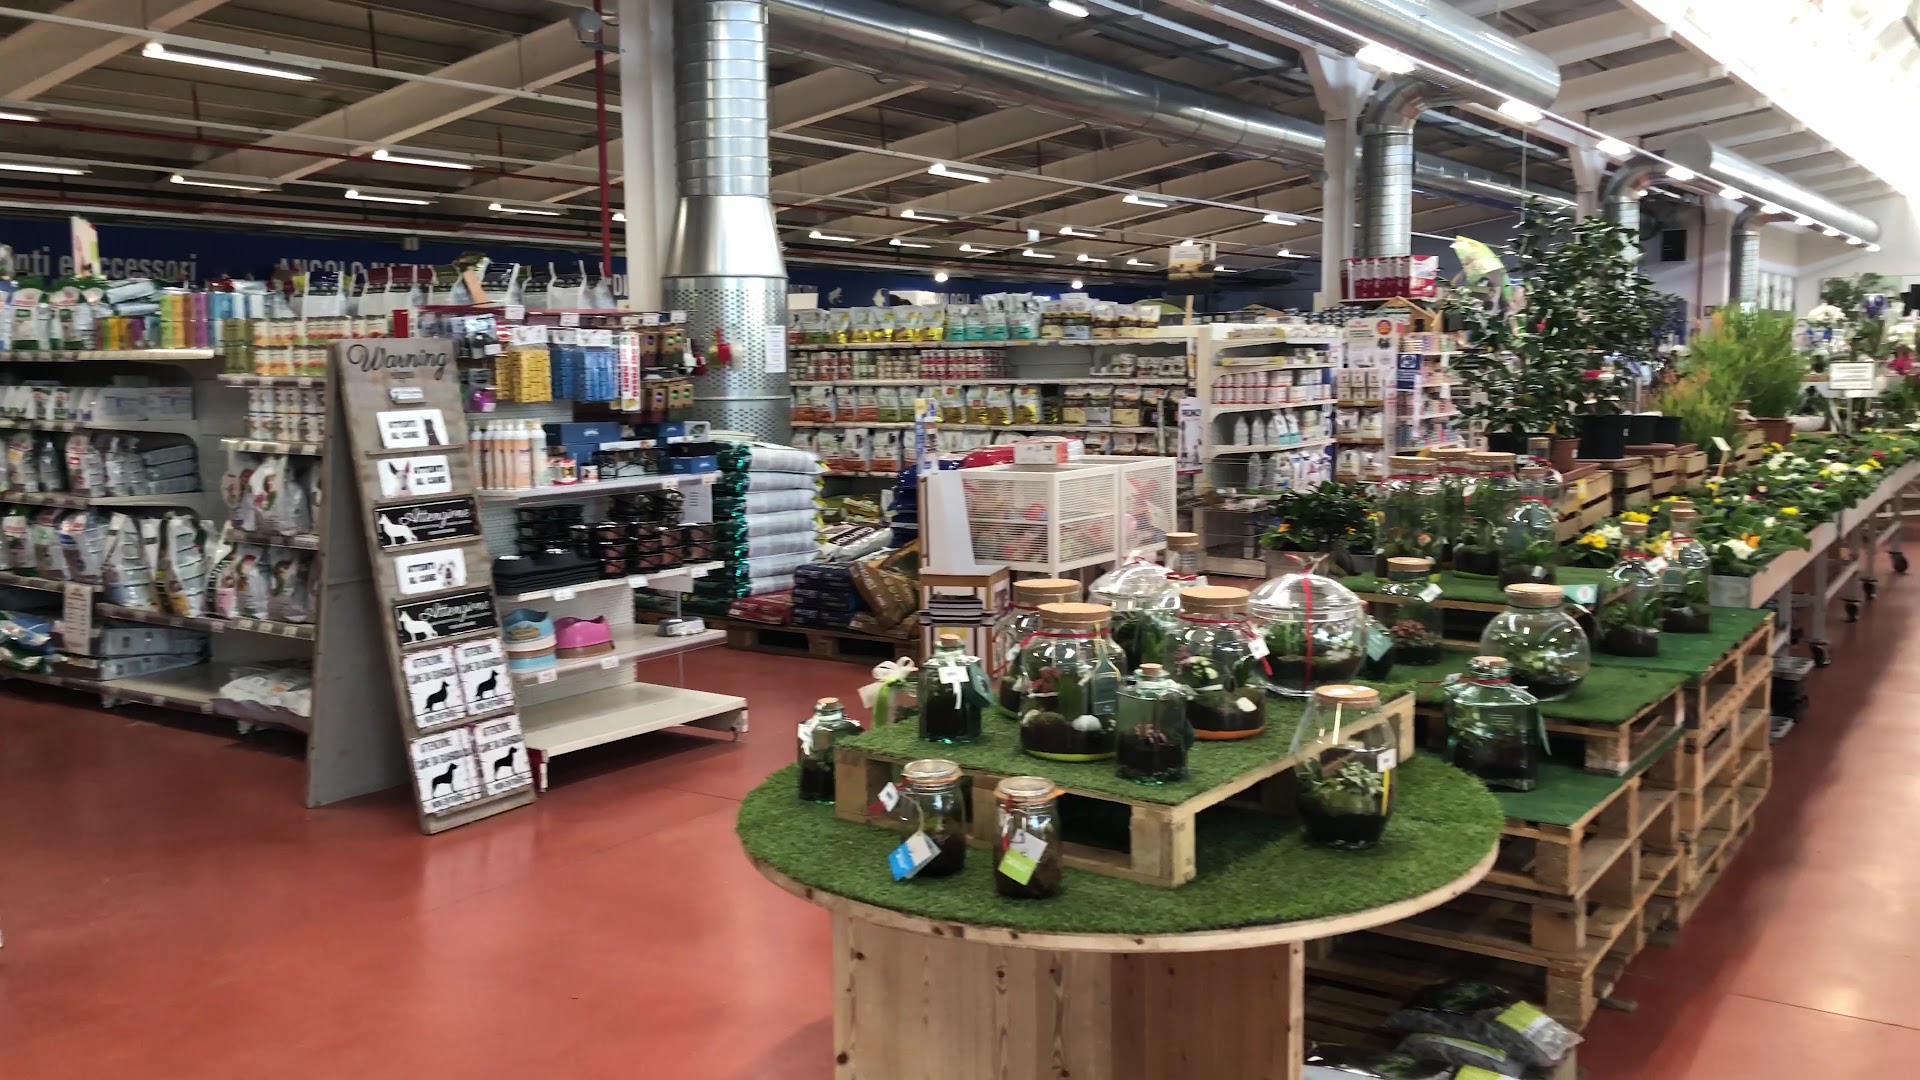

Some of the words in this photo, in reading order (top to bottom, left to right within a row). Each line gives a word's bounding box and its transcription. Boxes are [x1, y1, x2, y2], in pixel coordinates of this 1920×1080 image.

[14, 246, 51, 276] nti
[100, 253, 197, 281] ccessori
[346, 343, 447, 380] Warning
